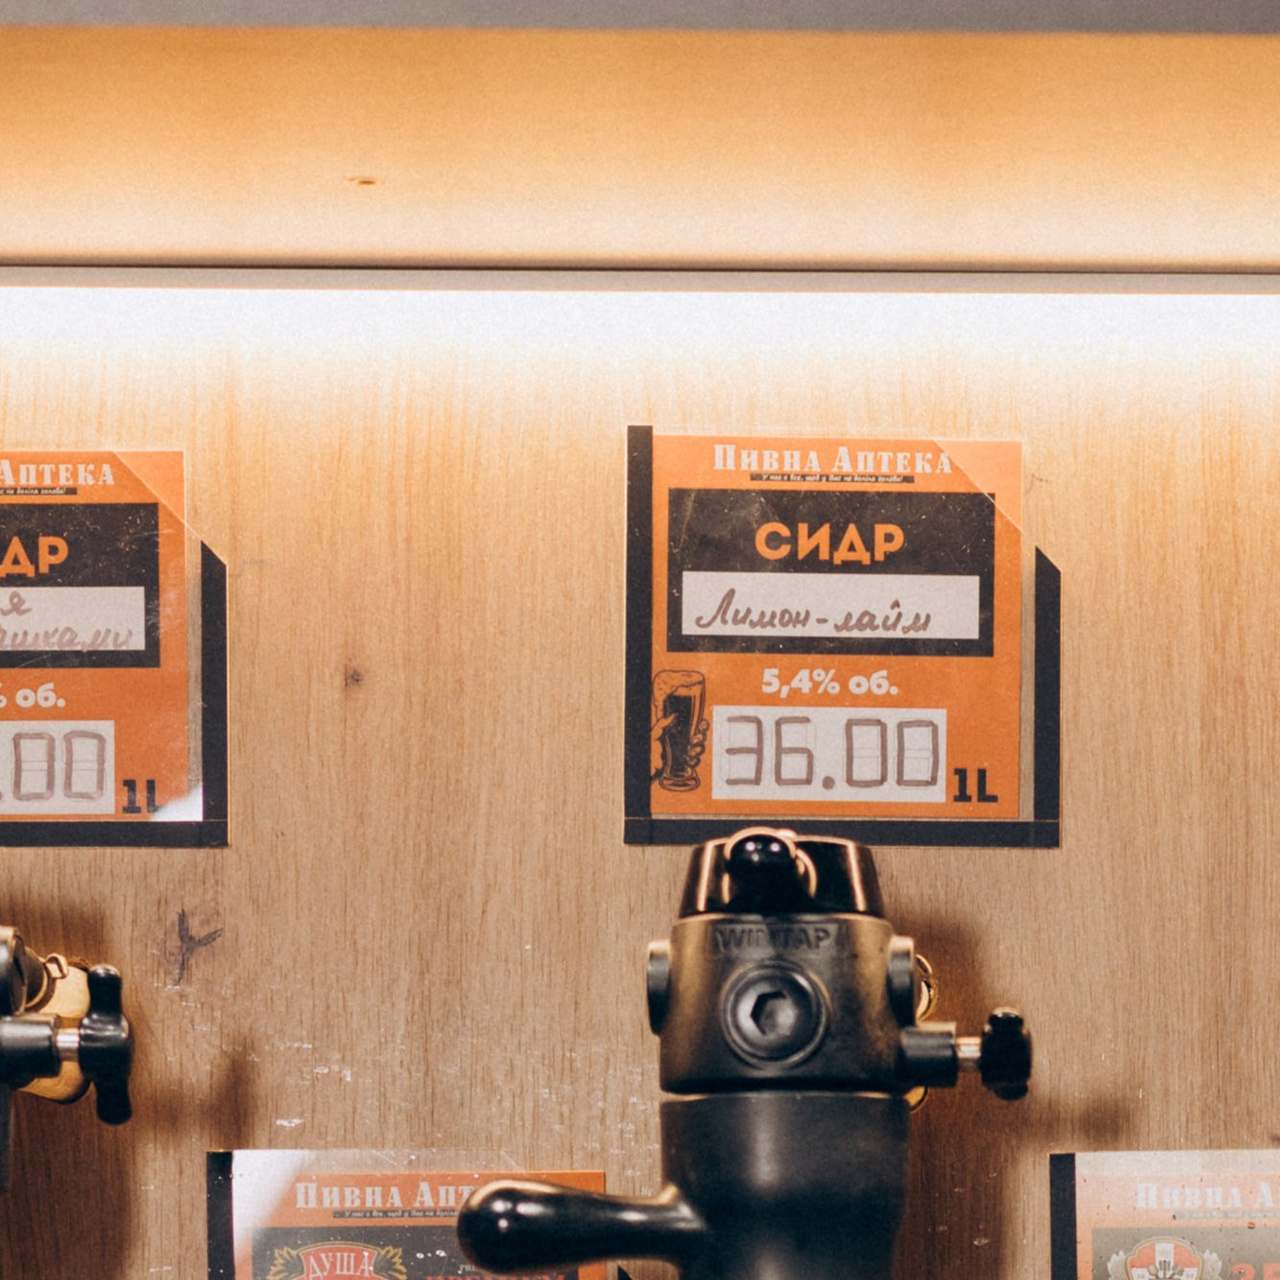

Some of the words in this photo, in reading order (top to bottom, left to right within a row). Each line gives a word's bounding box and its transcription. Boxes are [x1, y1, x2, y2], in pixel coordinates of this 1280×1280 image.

[755, 521, 904, 566] СИДР
[761, 667, 840, 698] 5,4%
[725, 715, 939, 790] 36.00
[953, 767, 998, 803] 1L
[413, 1181, 475, 1207] АПТ
